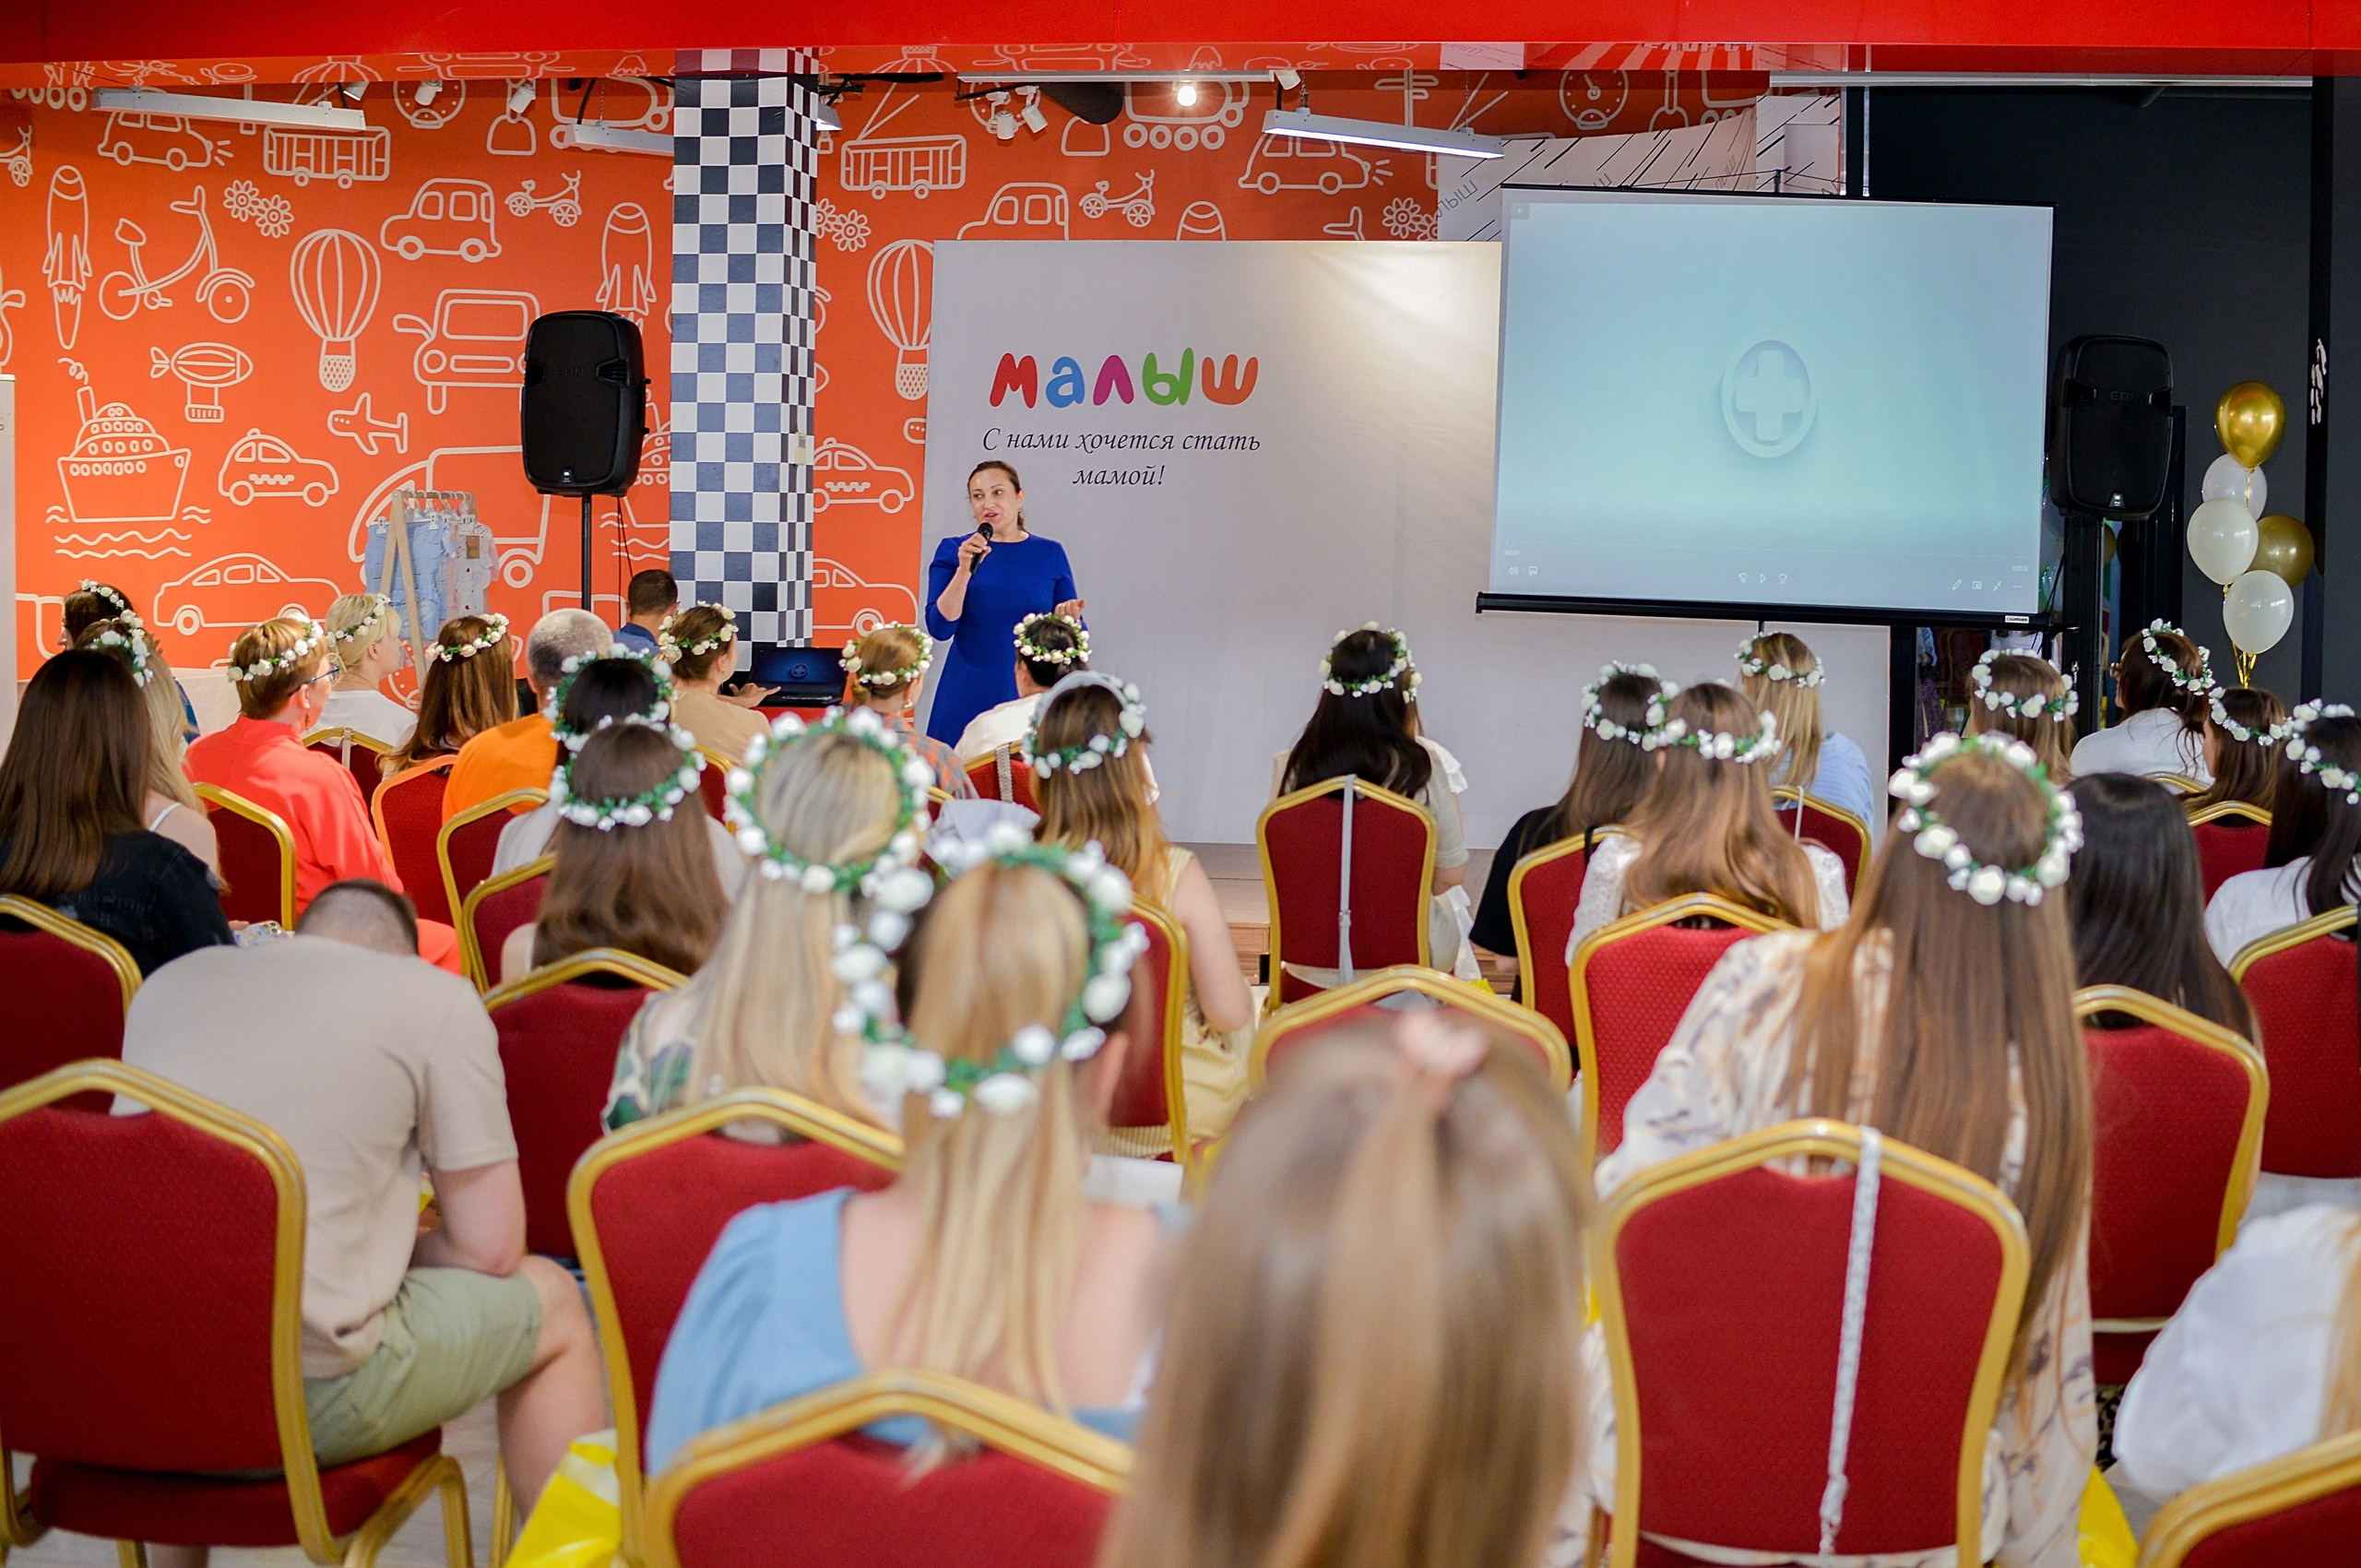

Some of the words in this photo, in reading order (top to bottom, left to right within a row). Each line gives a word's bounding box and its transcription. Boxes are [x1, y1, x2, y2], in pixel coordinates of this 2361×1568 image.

[983, 427, 1001, 451] С
[1006, 433, 1069, 449] нами
[1074, 434, 1175, 454] хочется
[1182, 434, 1261, 451] стать
[1073, 464, 1166, 485] мамой!
